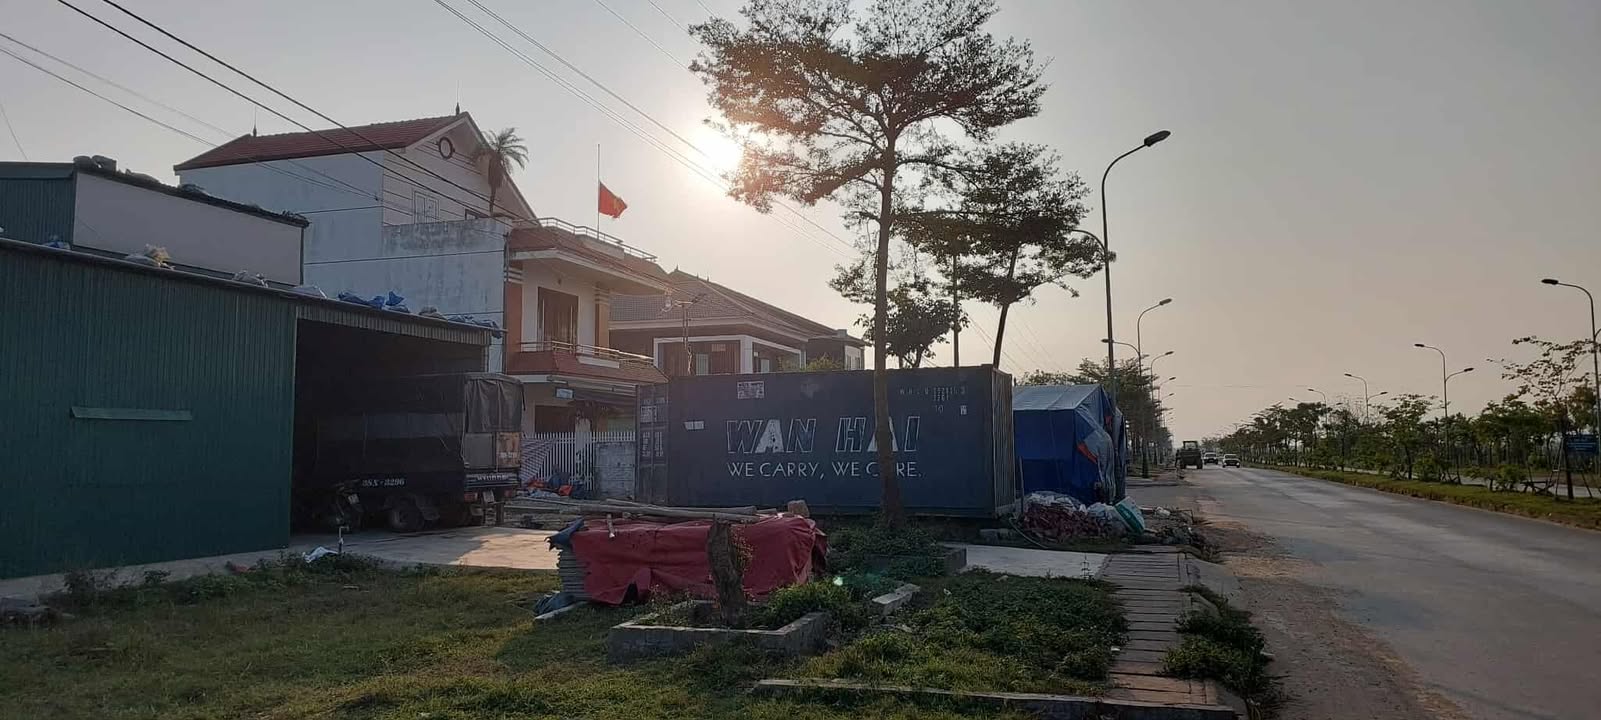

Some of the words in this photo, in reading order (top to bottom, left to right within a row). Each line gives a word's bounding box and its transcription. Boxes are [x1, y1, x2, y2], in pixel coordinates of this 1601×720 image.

[726, 418, 817, 454] WAN
[727, 462, 755, 477] WE
[759, 462, 825, 480] CARRY,
[832, 461, 860, 477] WE
[866, 461, 922, 477] CRE.
